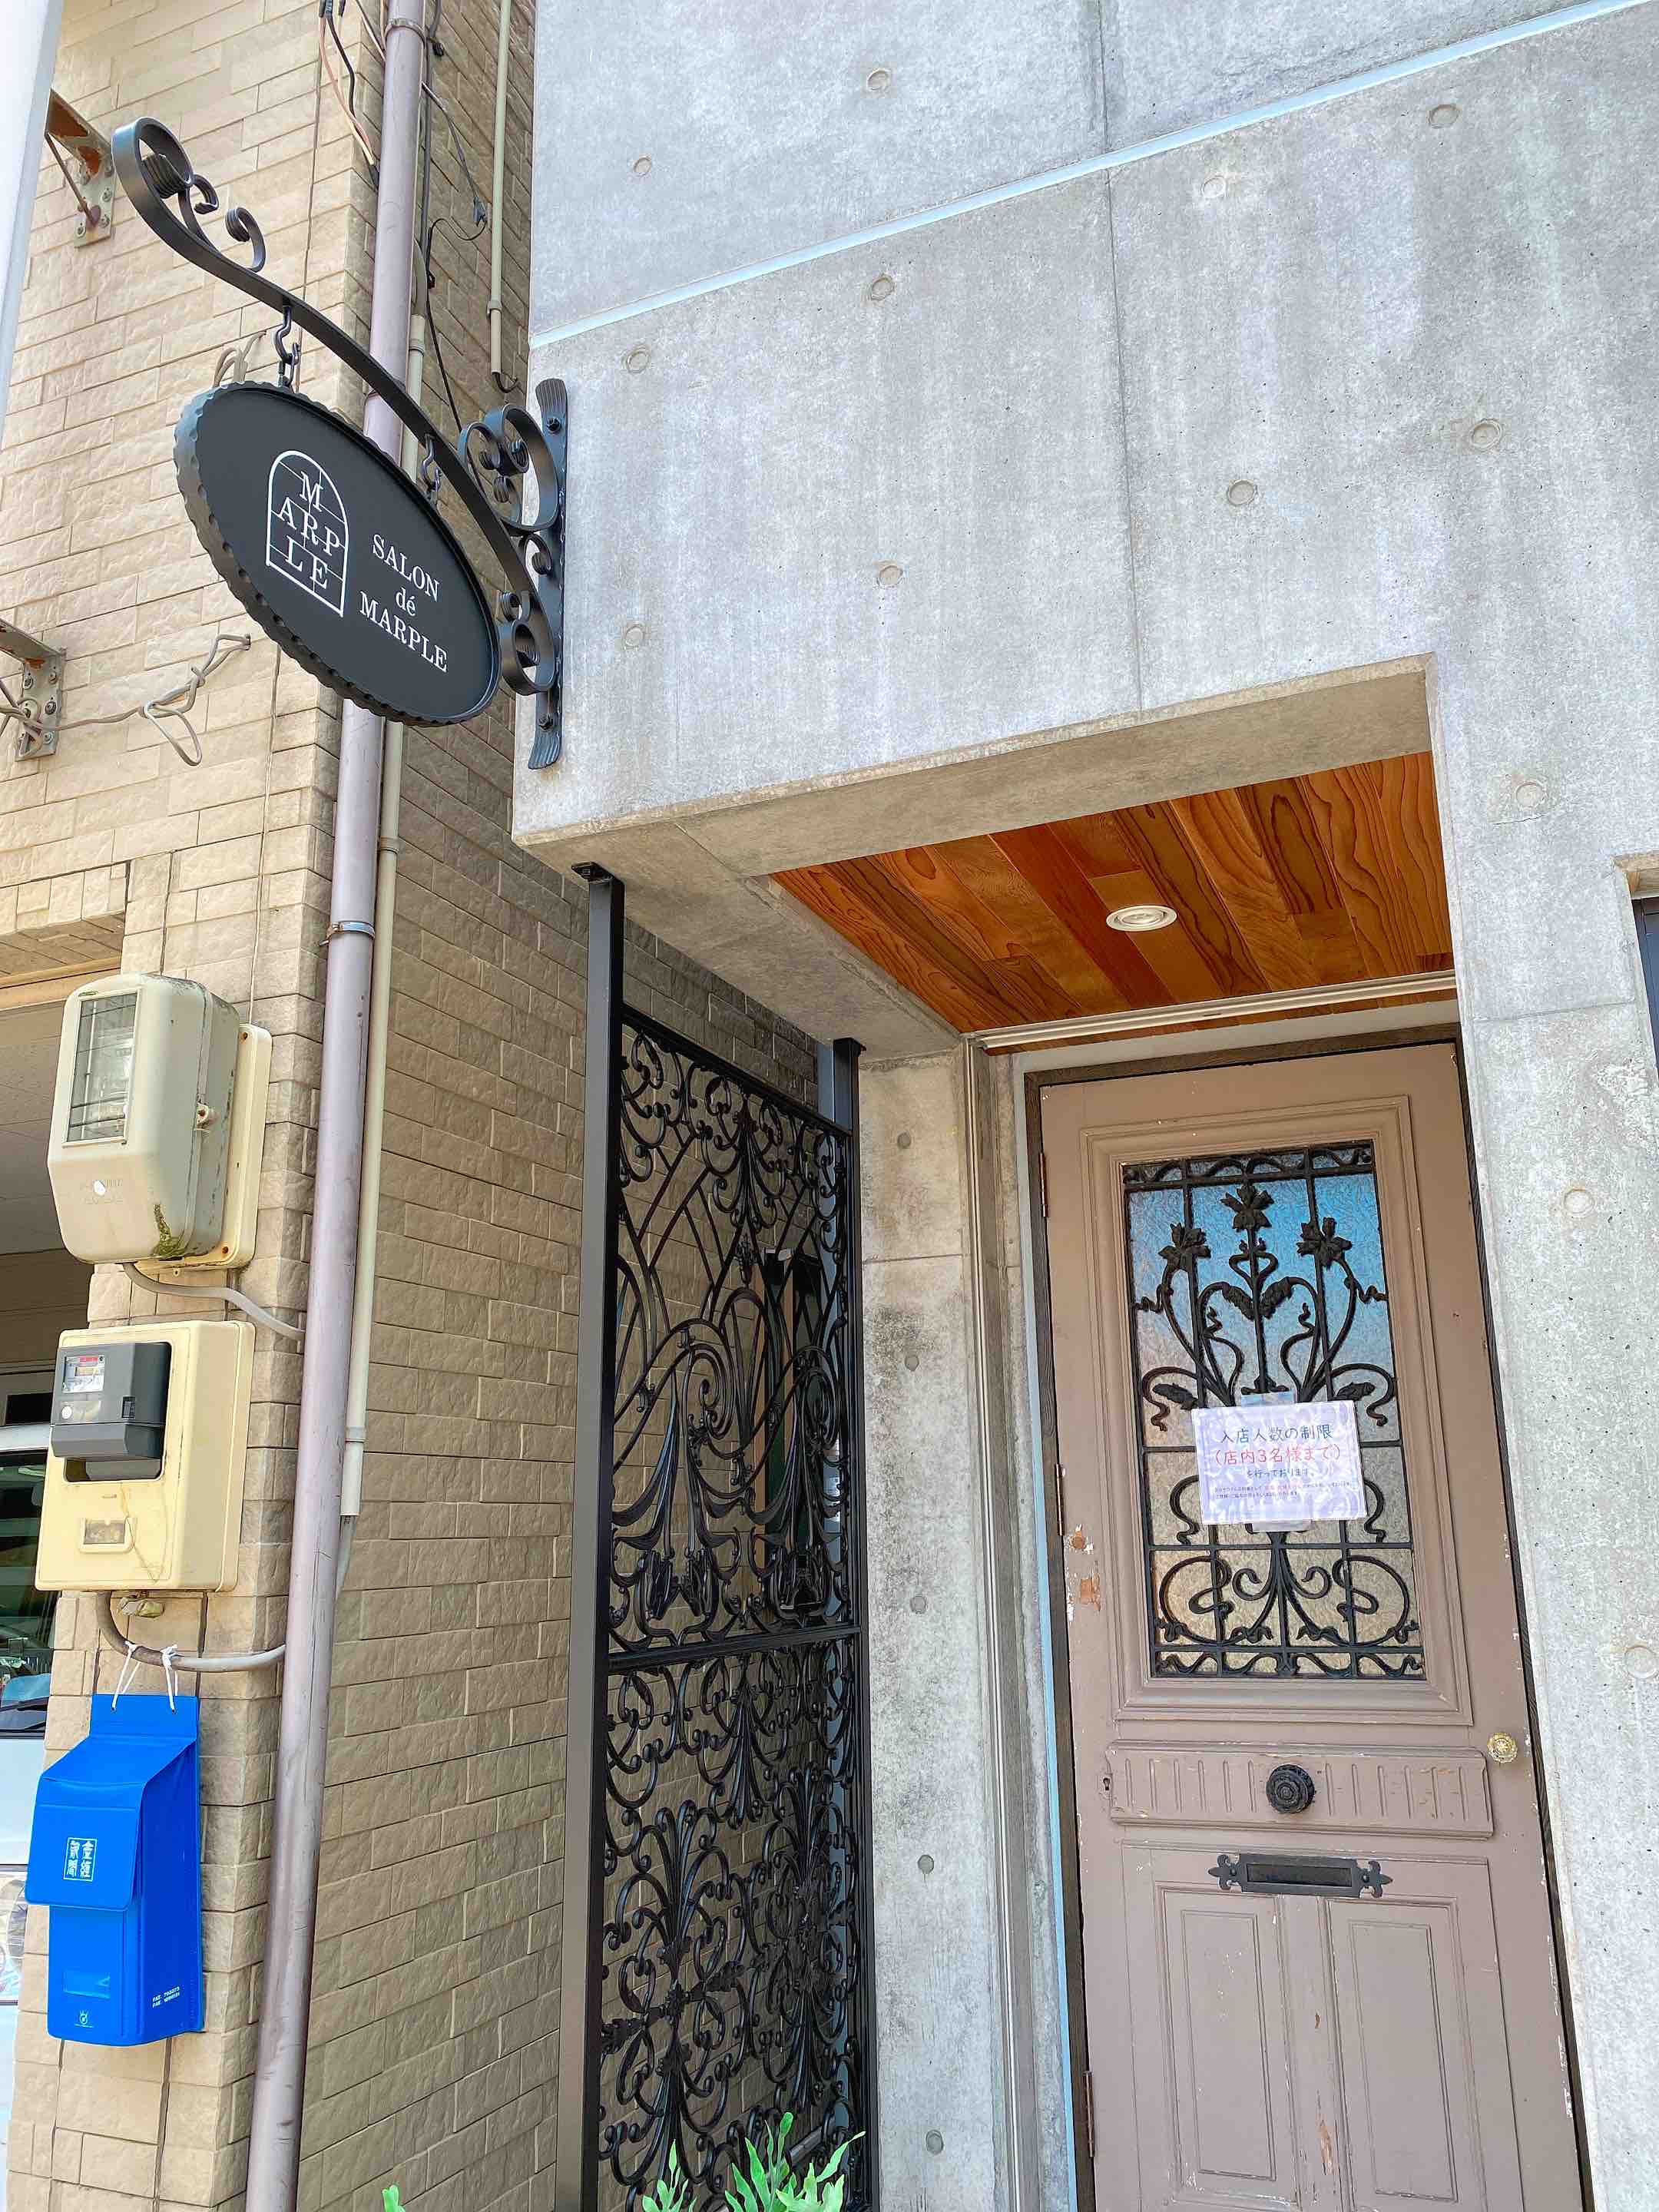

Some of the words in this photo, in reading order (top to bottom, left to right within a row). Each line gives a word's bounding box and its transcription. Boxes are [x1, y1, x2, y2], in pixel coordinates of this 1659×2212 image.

[373, 534, 440, 601] SALON
[396, 588, 416, 616] dé
[359, 591, 448, 673] MARPLE
[1221, 1425, 1333, 1443] 入店人数の制限
